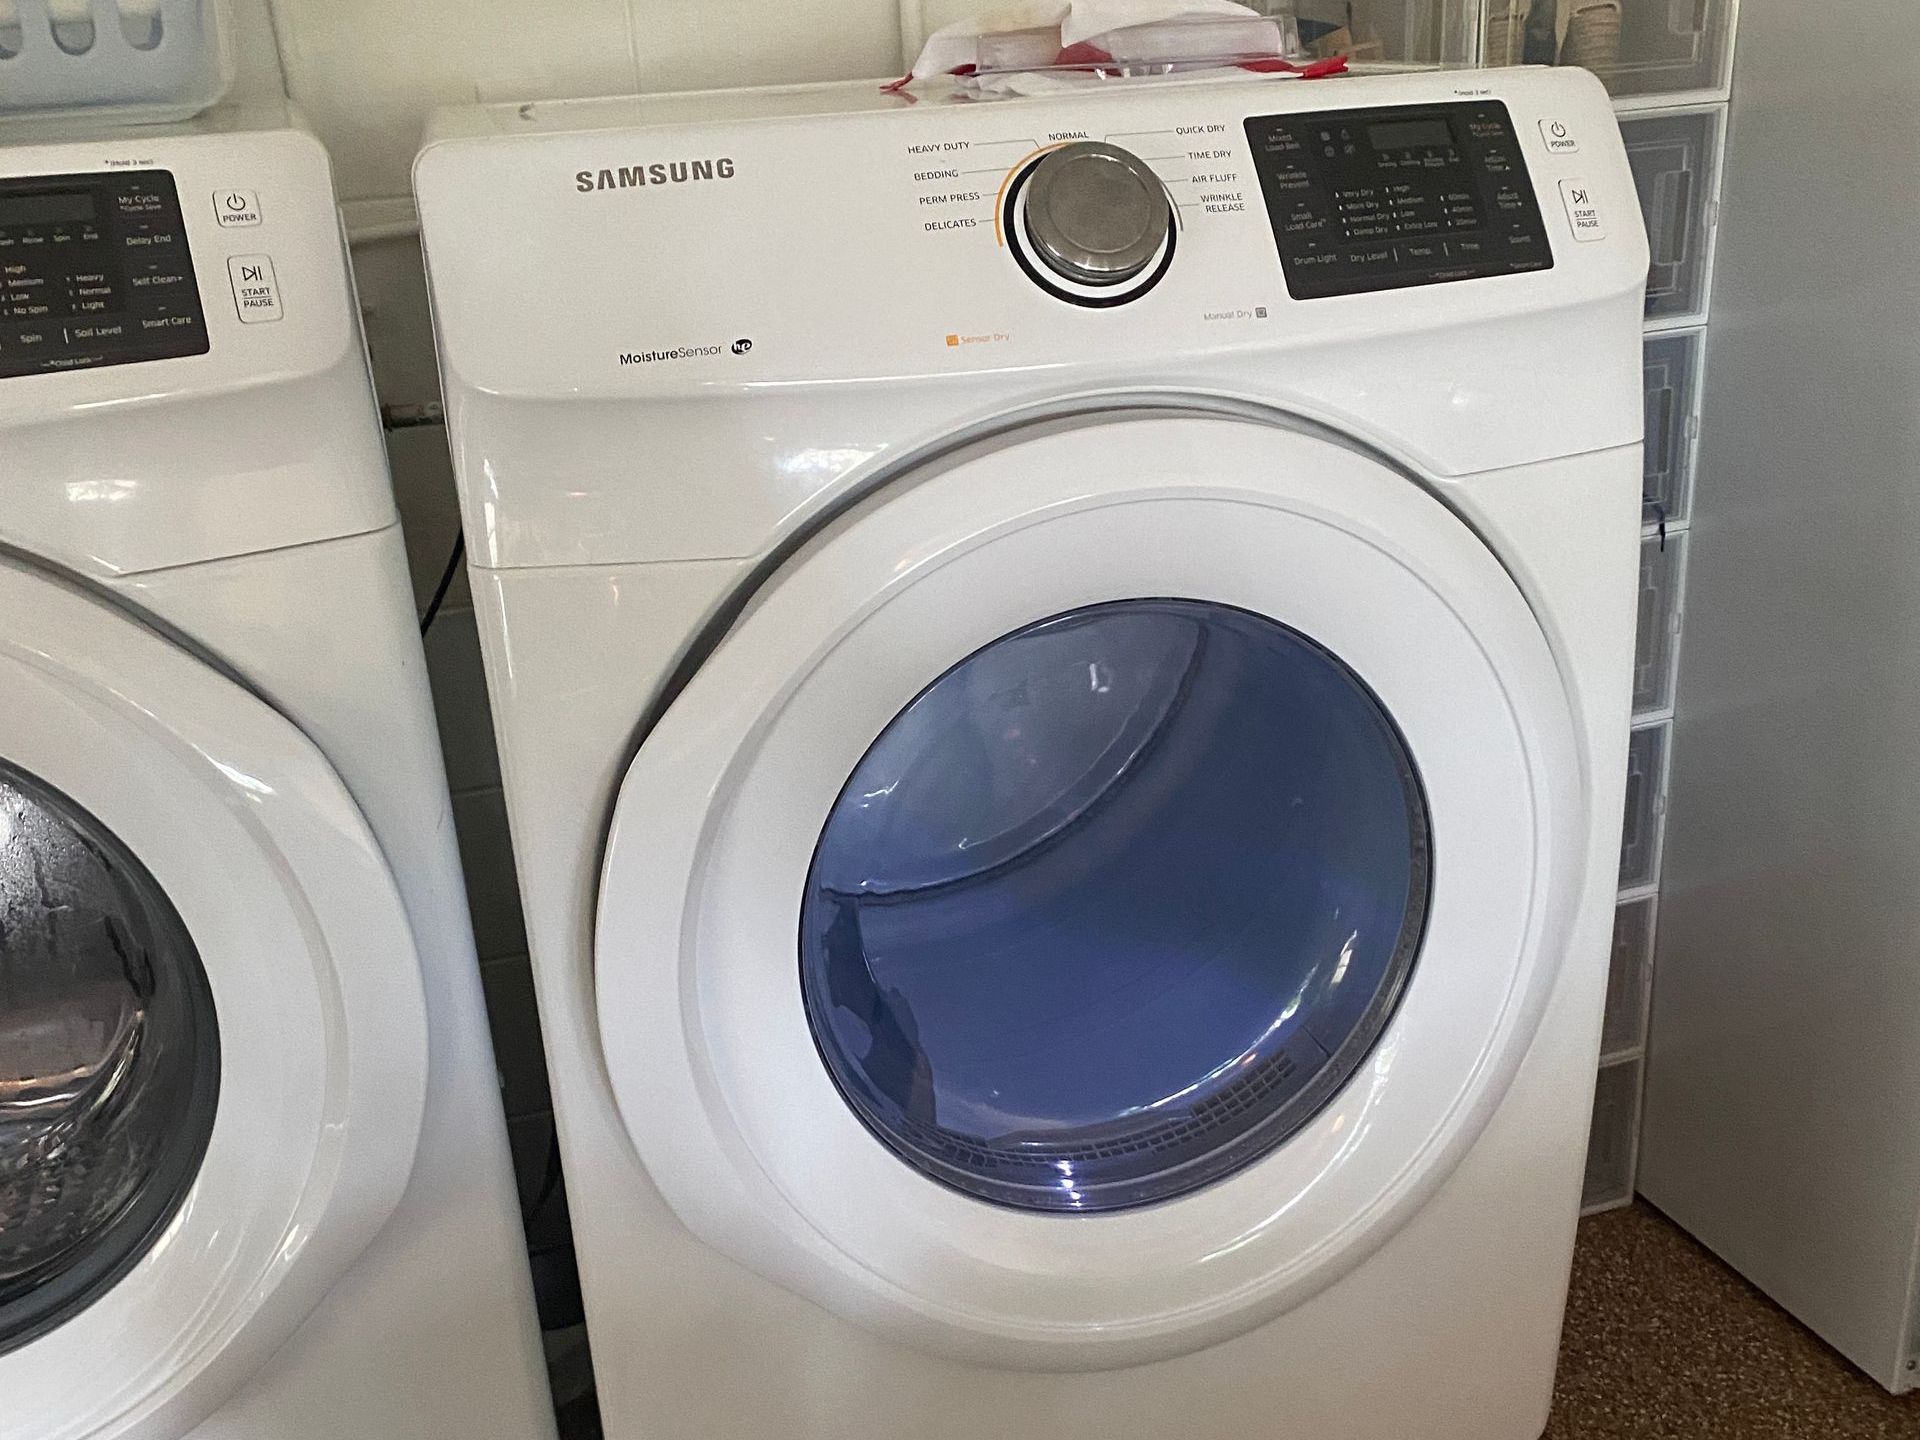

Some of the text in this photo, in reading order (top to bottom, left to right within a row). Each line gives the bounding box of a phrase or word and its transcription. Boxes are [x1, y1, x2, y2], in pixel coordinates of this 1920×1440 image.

[1175, 124, 1226, 135] QUICK DRY
[1048, 131, 1090, 141] NORMAL
[907, 141, 970, 154] HEAVY DUTY
[1550, 139, 1576, 148] POWER
[1188, 149, 1232, 160] TIME DRY
[575, 157, 736, 193] SAMSUNG
[914, 169, 959, 181] BEDDING
[1192, 173, 1238, 183] AIR FLUFF
[919, 191, 980, 206] PERM PRESS
[1200, 192, 1243, 203] WRINKLE
[1205, 203, 1246, 213] RELEASE
[1574, 209, 1597, 218] START
[222, 212, 257, 223] POWER
[924, 218, 977, 232] DELICATES
[1576, 220, 1599, 228] PAUSE
[126, 234, 172, 246] Delay End
[241, 287, 271, 297] START
[243, 298, 275, 308] PAUSE
[142, 316, 192, 329] Smart Care
[75, 326, 122, 338] Soil Level
[20, 334, 42, 343] Spin
[619, 344, 723, 366] MoistureSensor
